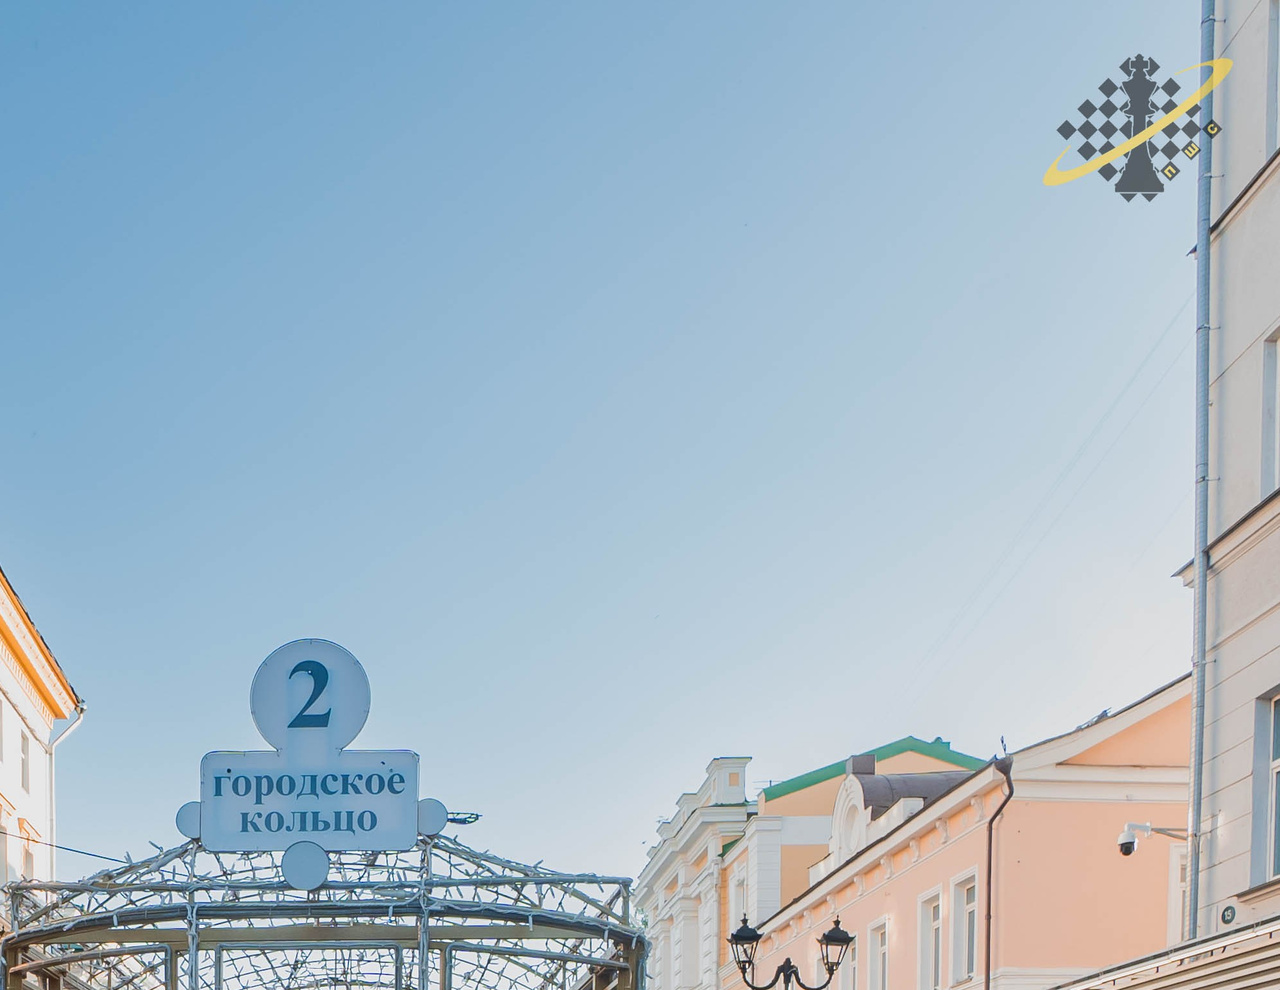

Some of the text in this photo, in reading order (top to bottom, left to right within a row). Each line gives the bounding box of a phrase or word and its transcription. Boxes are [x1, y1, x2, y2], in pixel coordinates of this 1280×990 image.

[287, 660, 331, 728] 2
[213, 772, 406, 805] городское
[239, 810, 378, 835] кольцо
